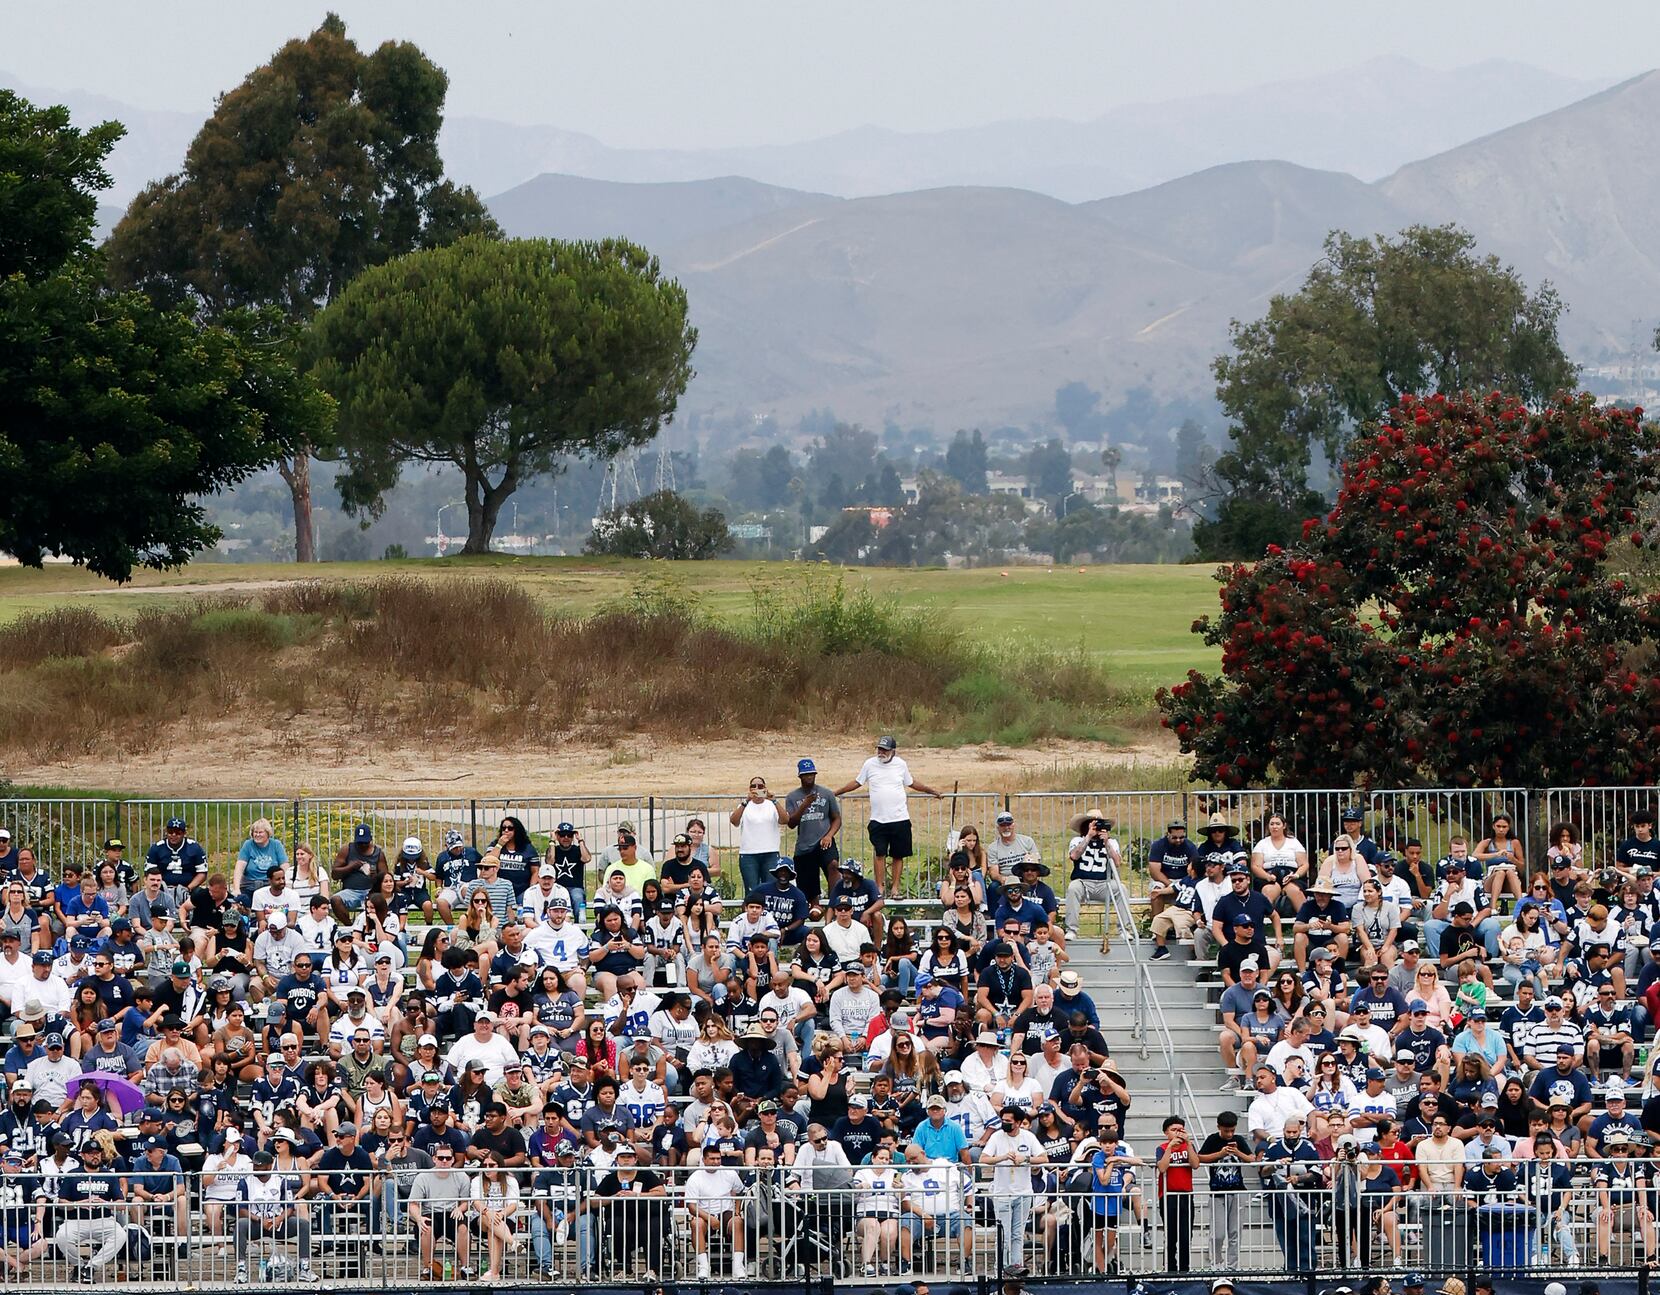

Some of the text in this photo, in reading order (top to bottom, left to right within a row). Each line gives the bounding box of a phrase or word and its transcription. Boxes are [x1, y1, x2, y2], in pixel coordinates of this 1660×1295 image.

[500, 853, 523, 861] DALLAS
[1078, 846, 1106, 872] 55
[314, 932, 324, 949] 4
[552, 940, 568, 962] 4
[338, 970, 349, 984] 8
[288, 988, 316, 1000] COWBOYS
[541, 1001, 568, 1010] DALLAS
[1391, 1084, 1418, 1095] DALLAS
[626, 1103, 655, 1128] 88
[1601, 1123, 1635, 1136] DALLAS
[12, 1126, 34, 1150] 21
